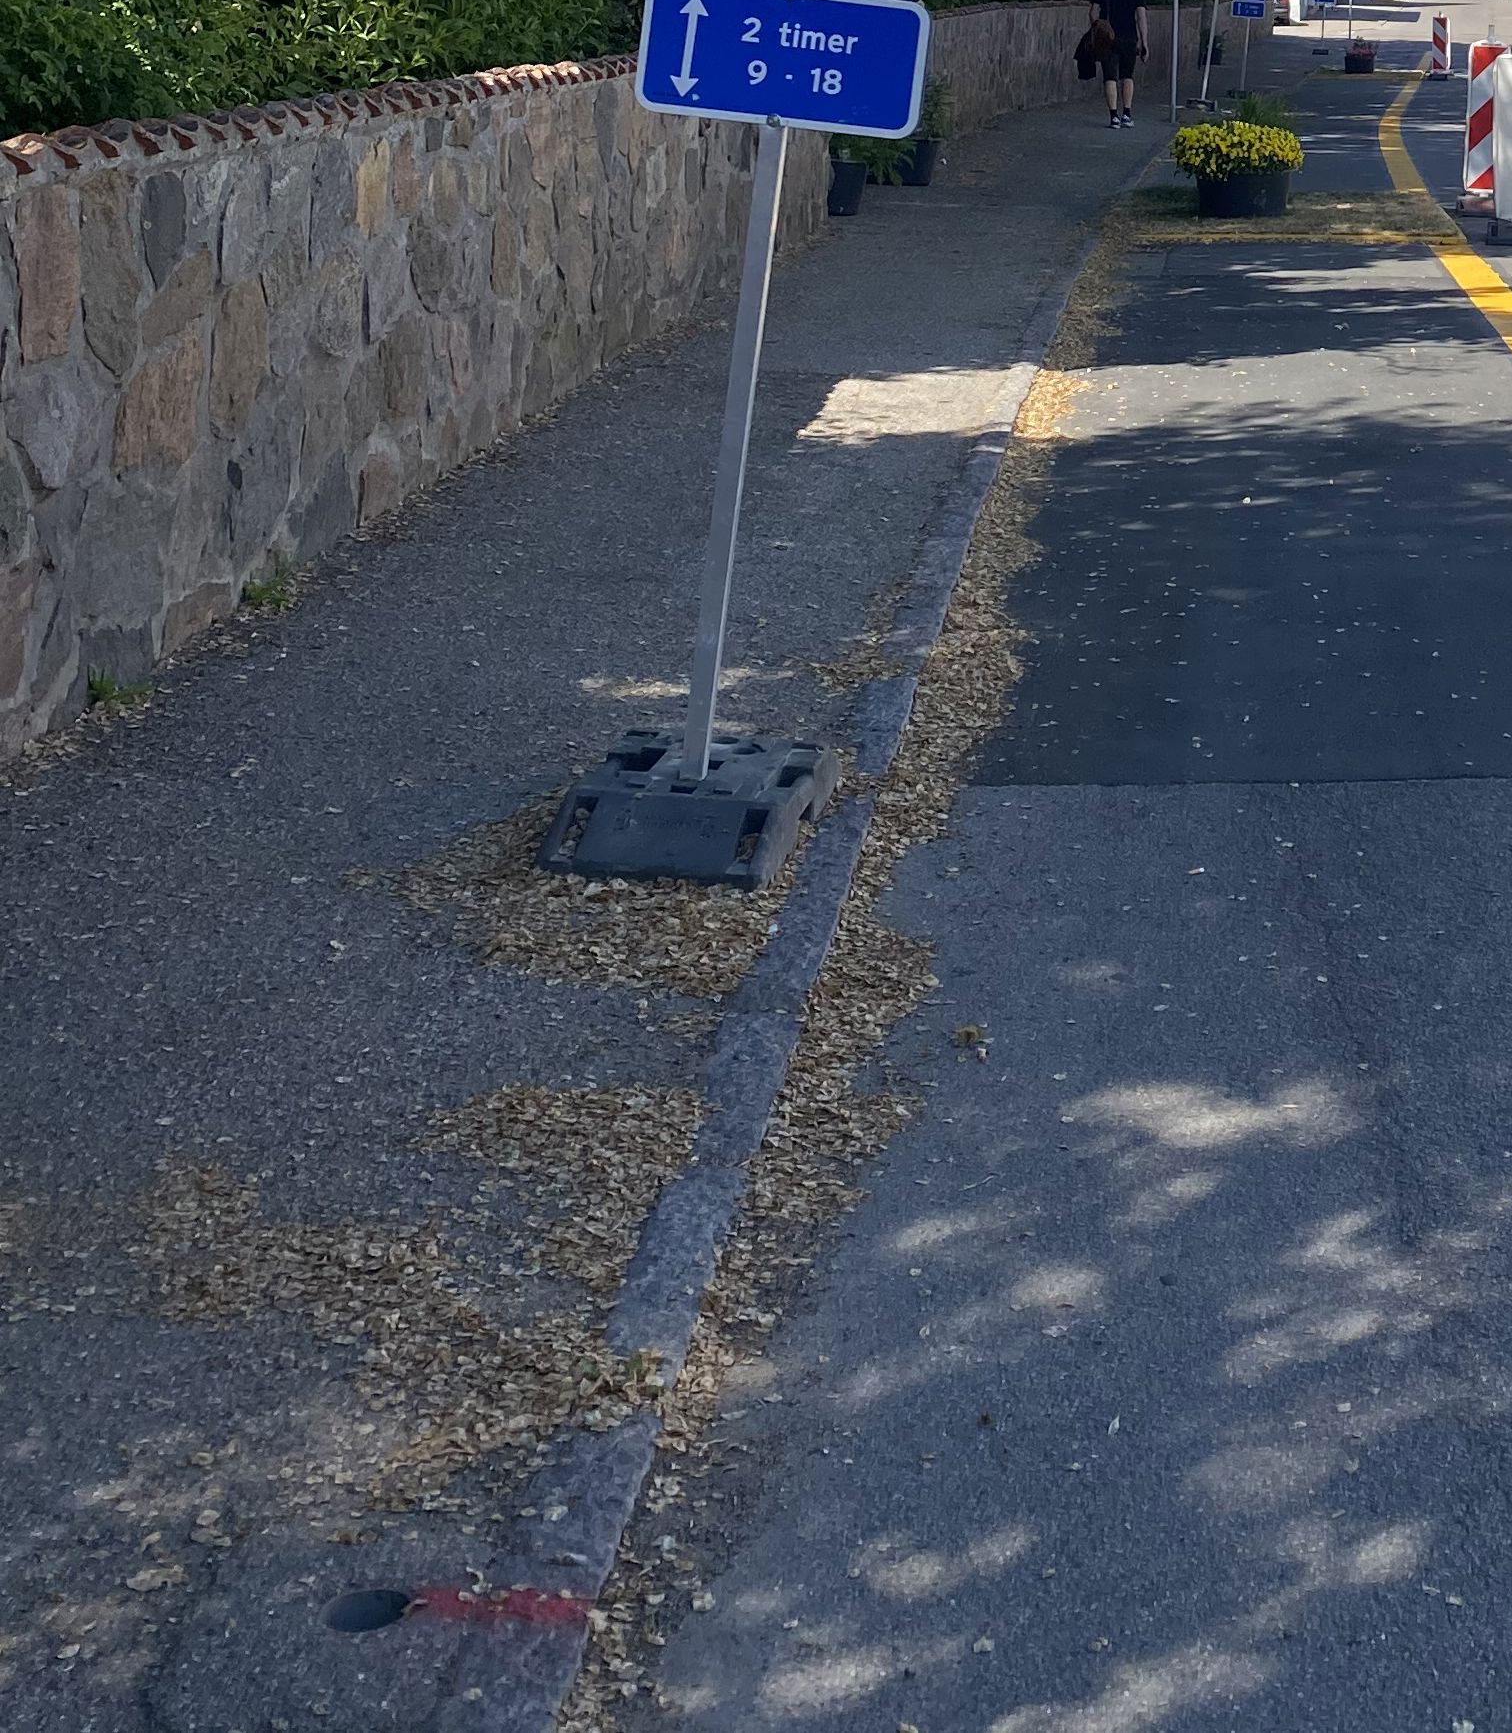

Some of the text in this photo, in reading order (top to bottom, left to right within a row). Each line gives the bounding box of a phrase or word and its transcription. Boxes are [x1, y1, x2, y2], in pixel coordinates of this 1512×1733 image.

[741, 17, 859, 55] 2 timer
[747, 60, 768, 85] 9
[811, 68, 843, 95] 18
